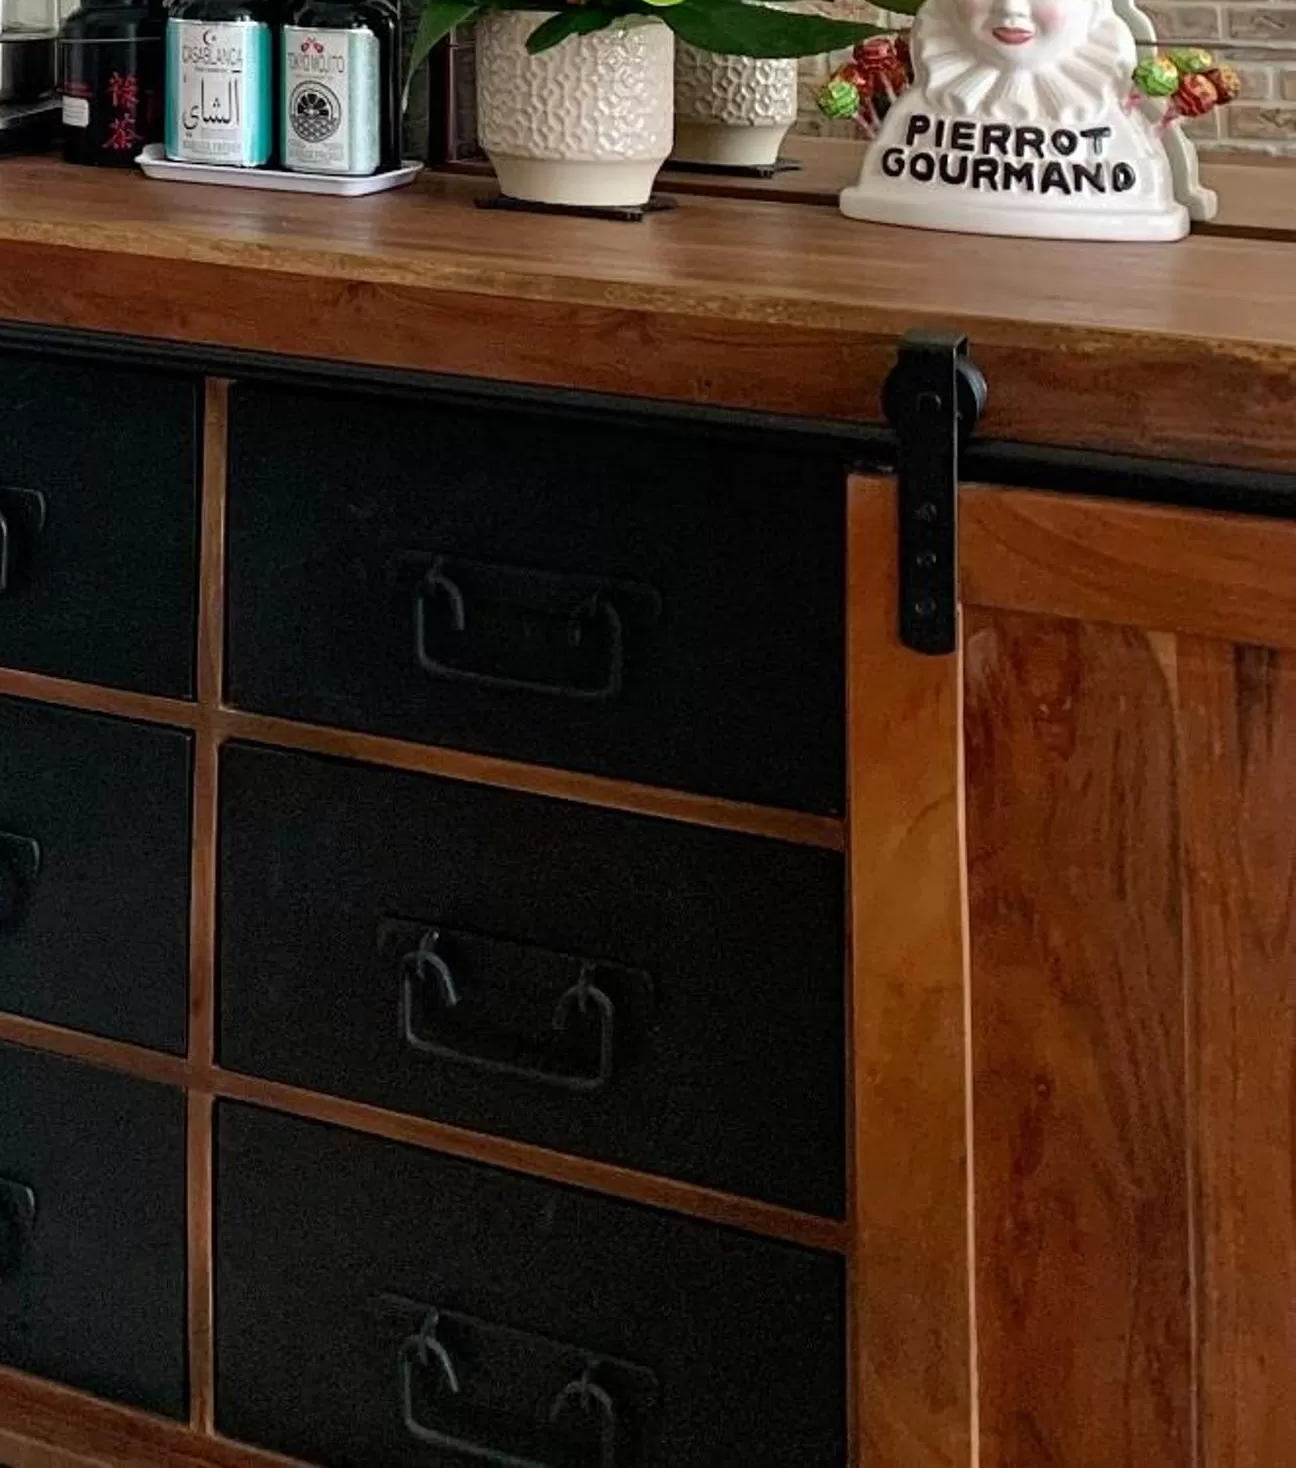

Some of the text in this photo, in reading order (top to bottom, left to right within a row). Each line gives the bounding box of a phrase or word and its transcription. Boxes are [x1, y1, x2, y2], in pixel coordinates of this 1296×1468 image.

[182, 45, 243, 65] CASABLANCA
[905, 114, 1113, 159] PIERROT
[881, 147, 1137, 195] GOURMAND
